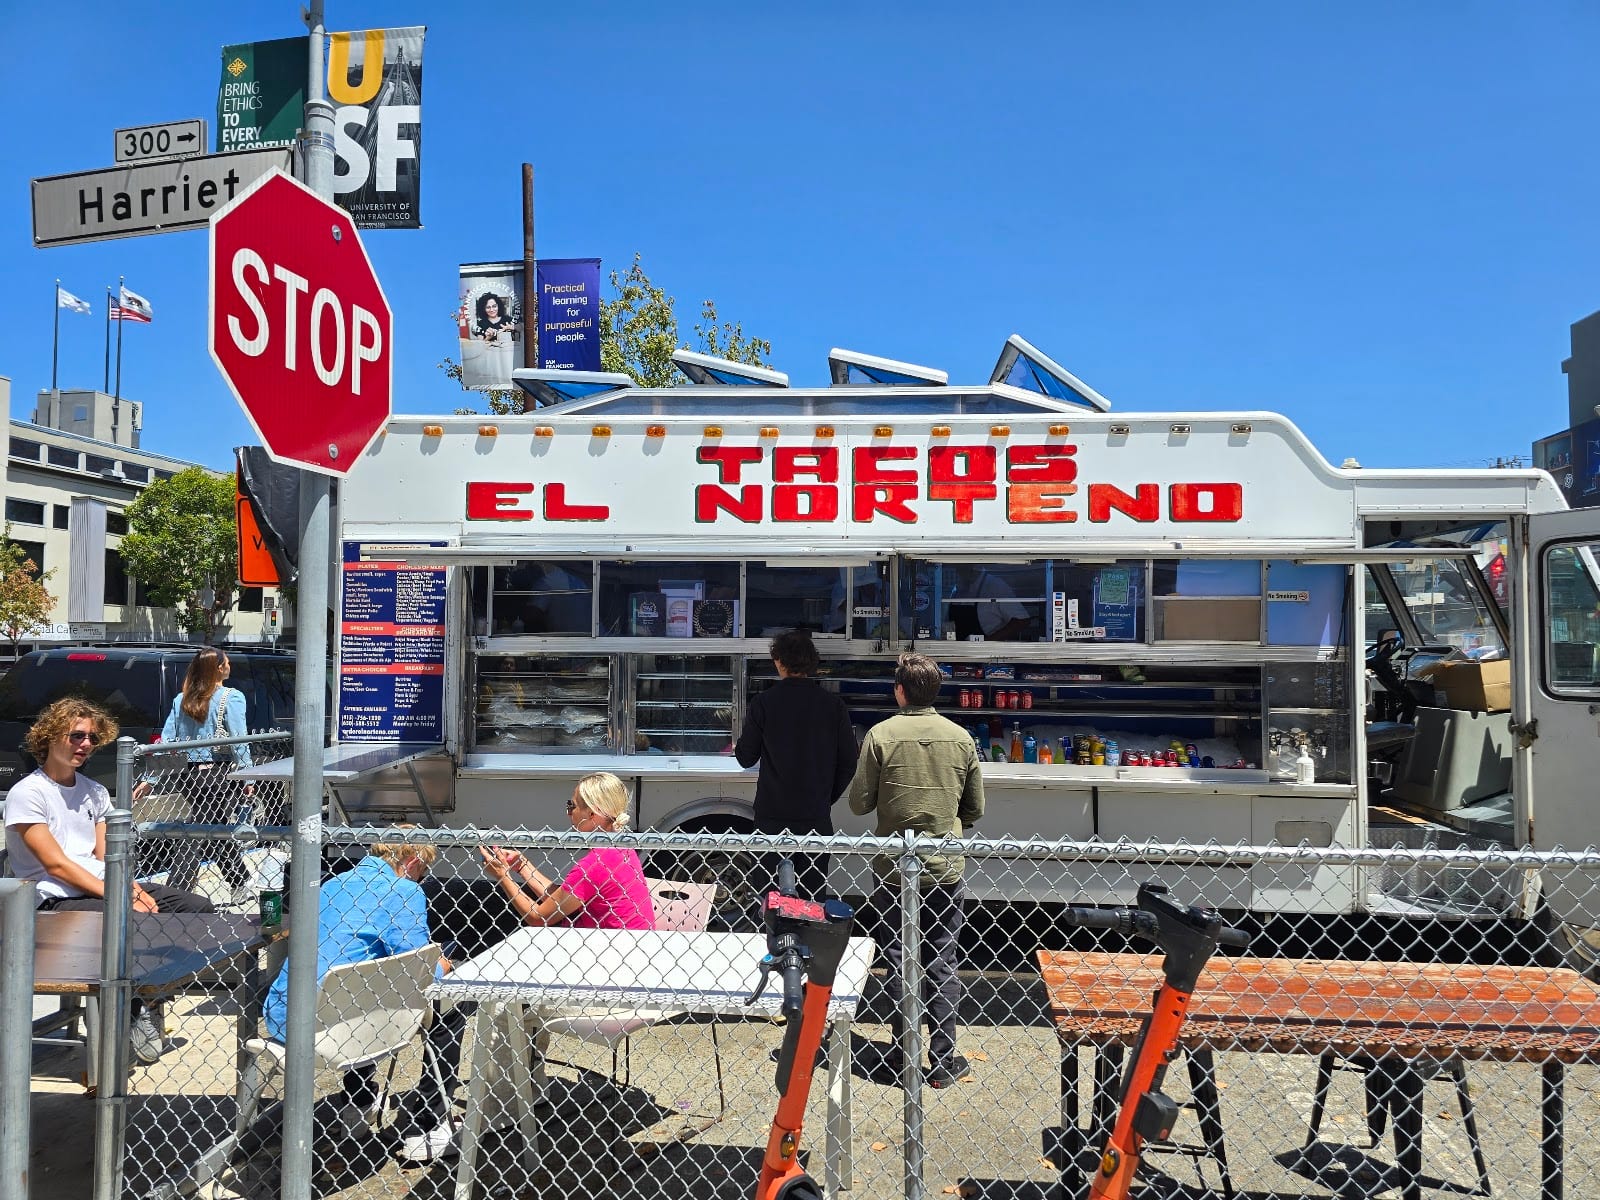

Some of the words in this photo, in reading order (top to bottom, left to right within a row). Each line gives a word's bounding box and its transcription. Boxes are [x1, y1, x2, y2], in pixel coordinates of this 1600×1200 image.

[224, 81, 260, 98] BRING
[223, 96, 263, 112] ETHICS
[223, 112, 240, 127] TO
[223, 126, 262, 142] EVERY
[124, 129, 171, 157] 300
[79, 168, 240, 225] Harriet
[350, 203, 396, 211] UNIVERSITY
[399, 202, 410, 211] OF
[368, 211, 410, 221] FRANCISCO
[544, 283, 585, 294] Practical
[552, 295, 588, 306] learning
[566, 307, 580, 317] for
[227, 247, 383, 396] STOP
[545, 318, 592, 333] purposeful
[555, 333, 586, 345] people.
[696, 445, 1078, 485] TACOS
[466, 482, 610, 521] EL
[696, 483, 1243, 524] NORTENO
[1275, 592, 1298, 601] Smoking
[860, 608, 881, 616] Smoking
[1074, 629, 1095, 637] Smoking
